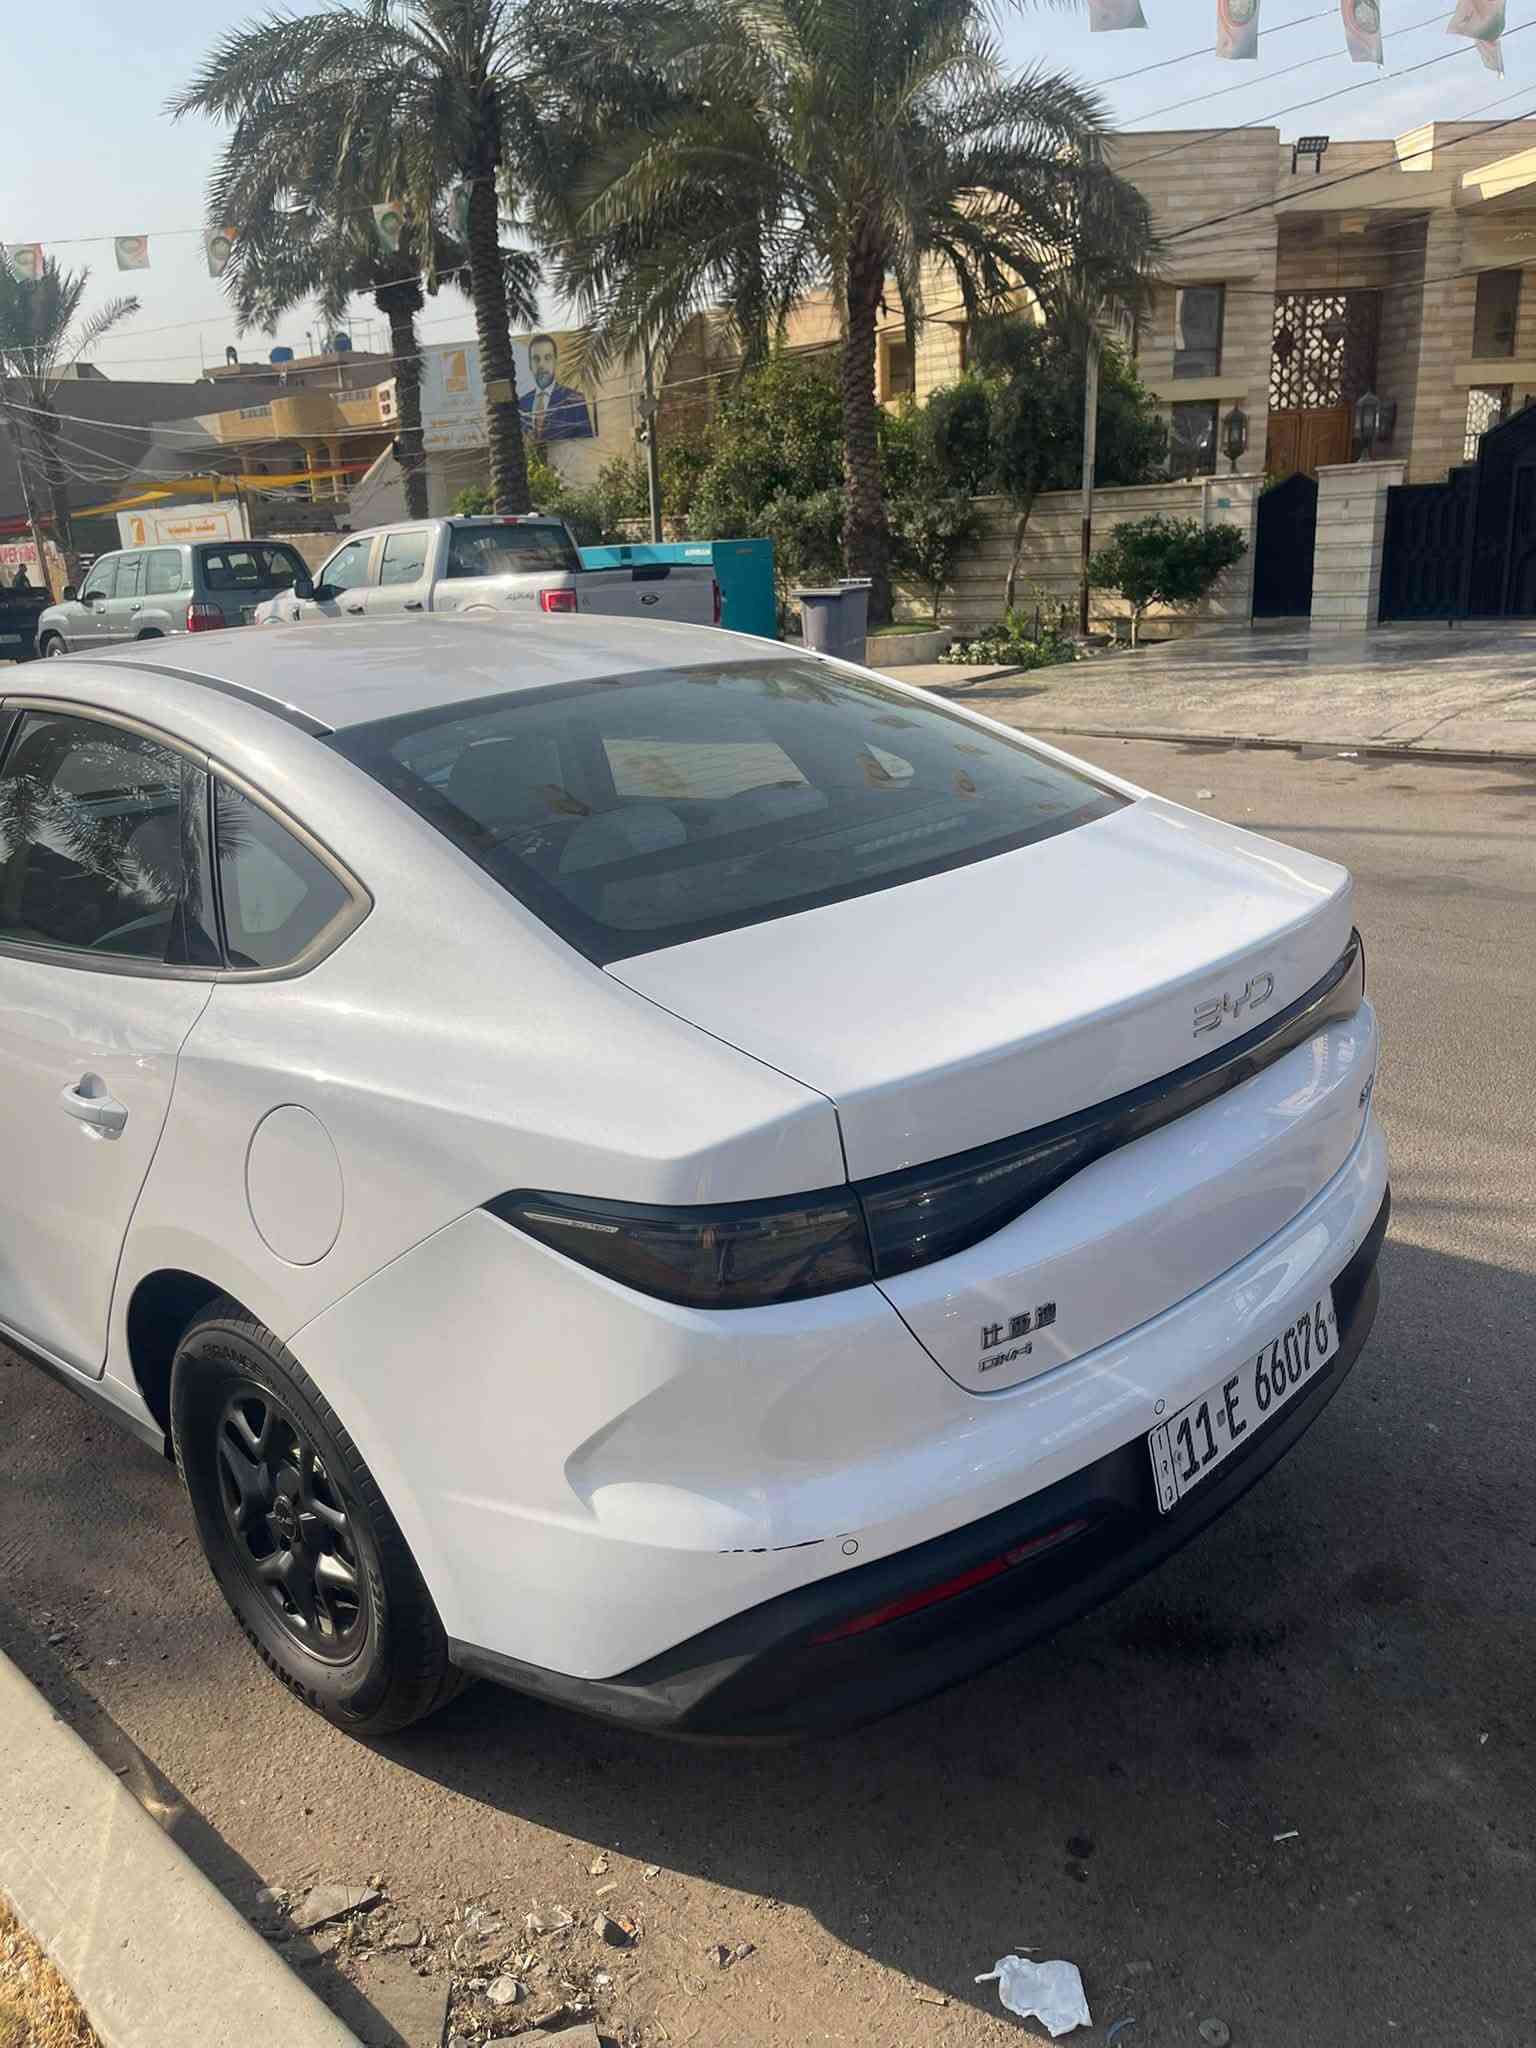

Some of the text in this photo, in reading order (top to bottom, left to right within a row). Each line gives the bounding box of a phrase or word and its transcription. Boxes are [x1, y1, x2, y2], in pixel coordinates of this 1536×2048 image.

[1192, 971, 1274, 1038] BYD
[1177, 1301, 1329, 1482] 11 E 66076
